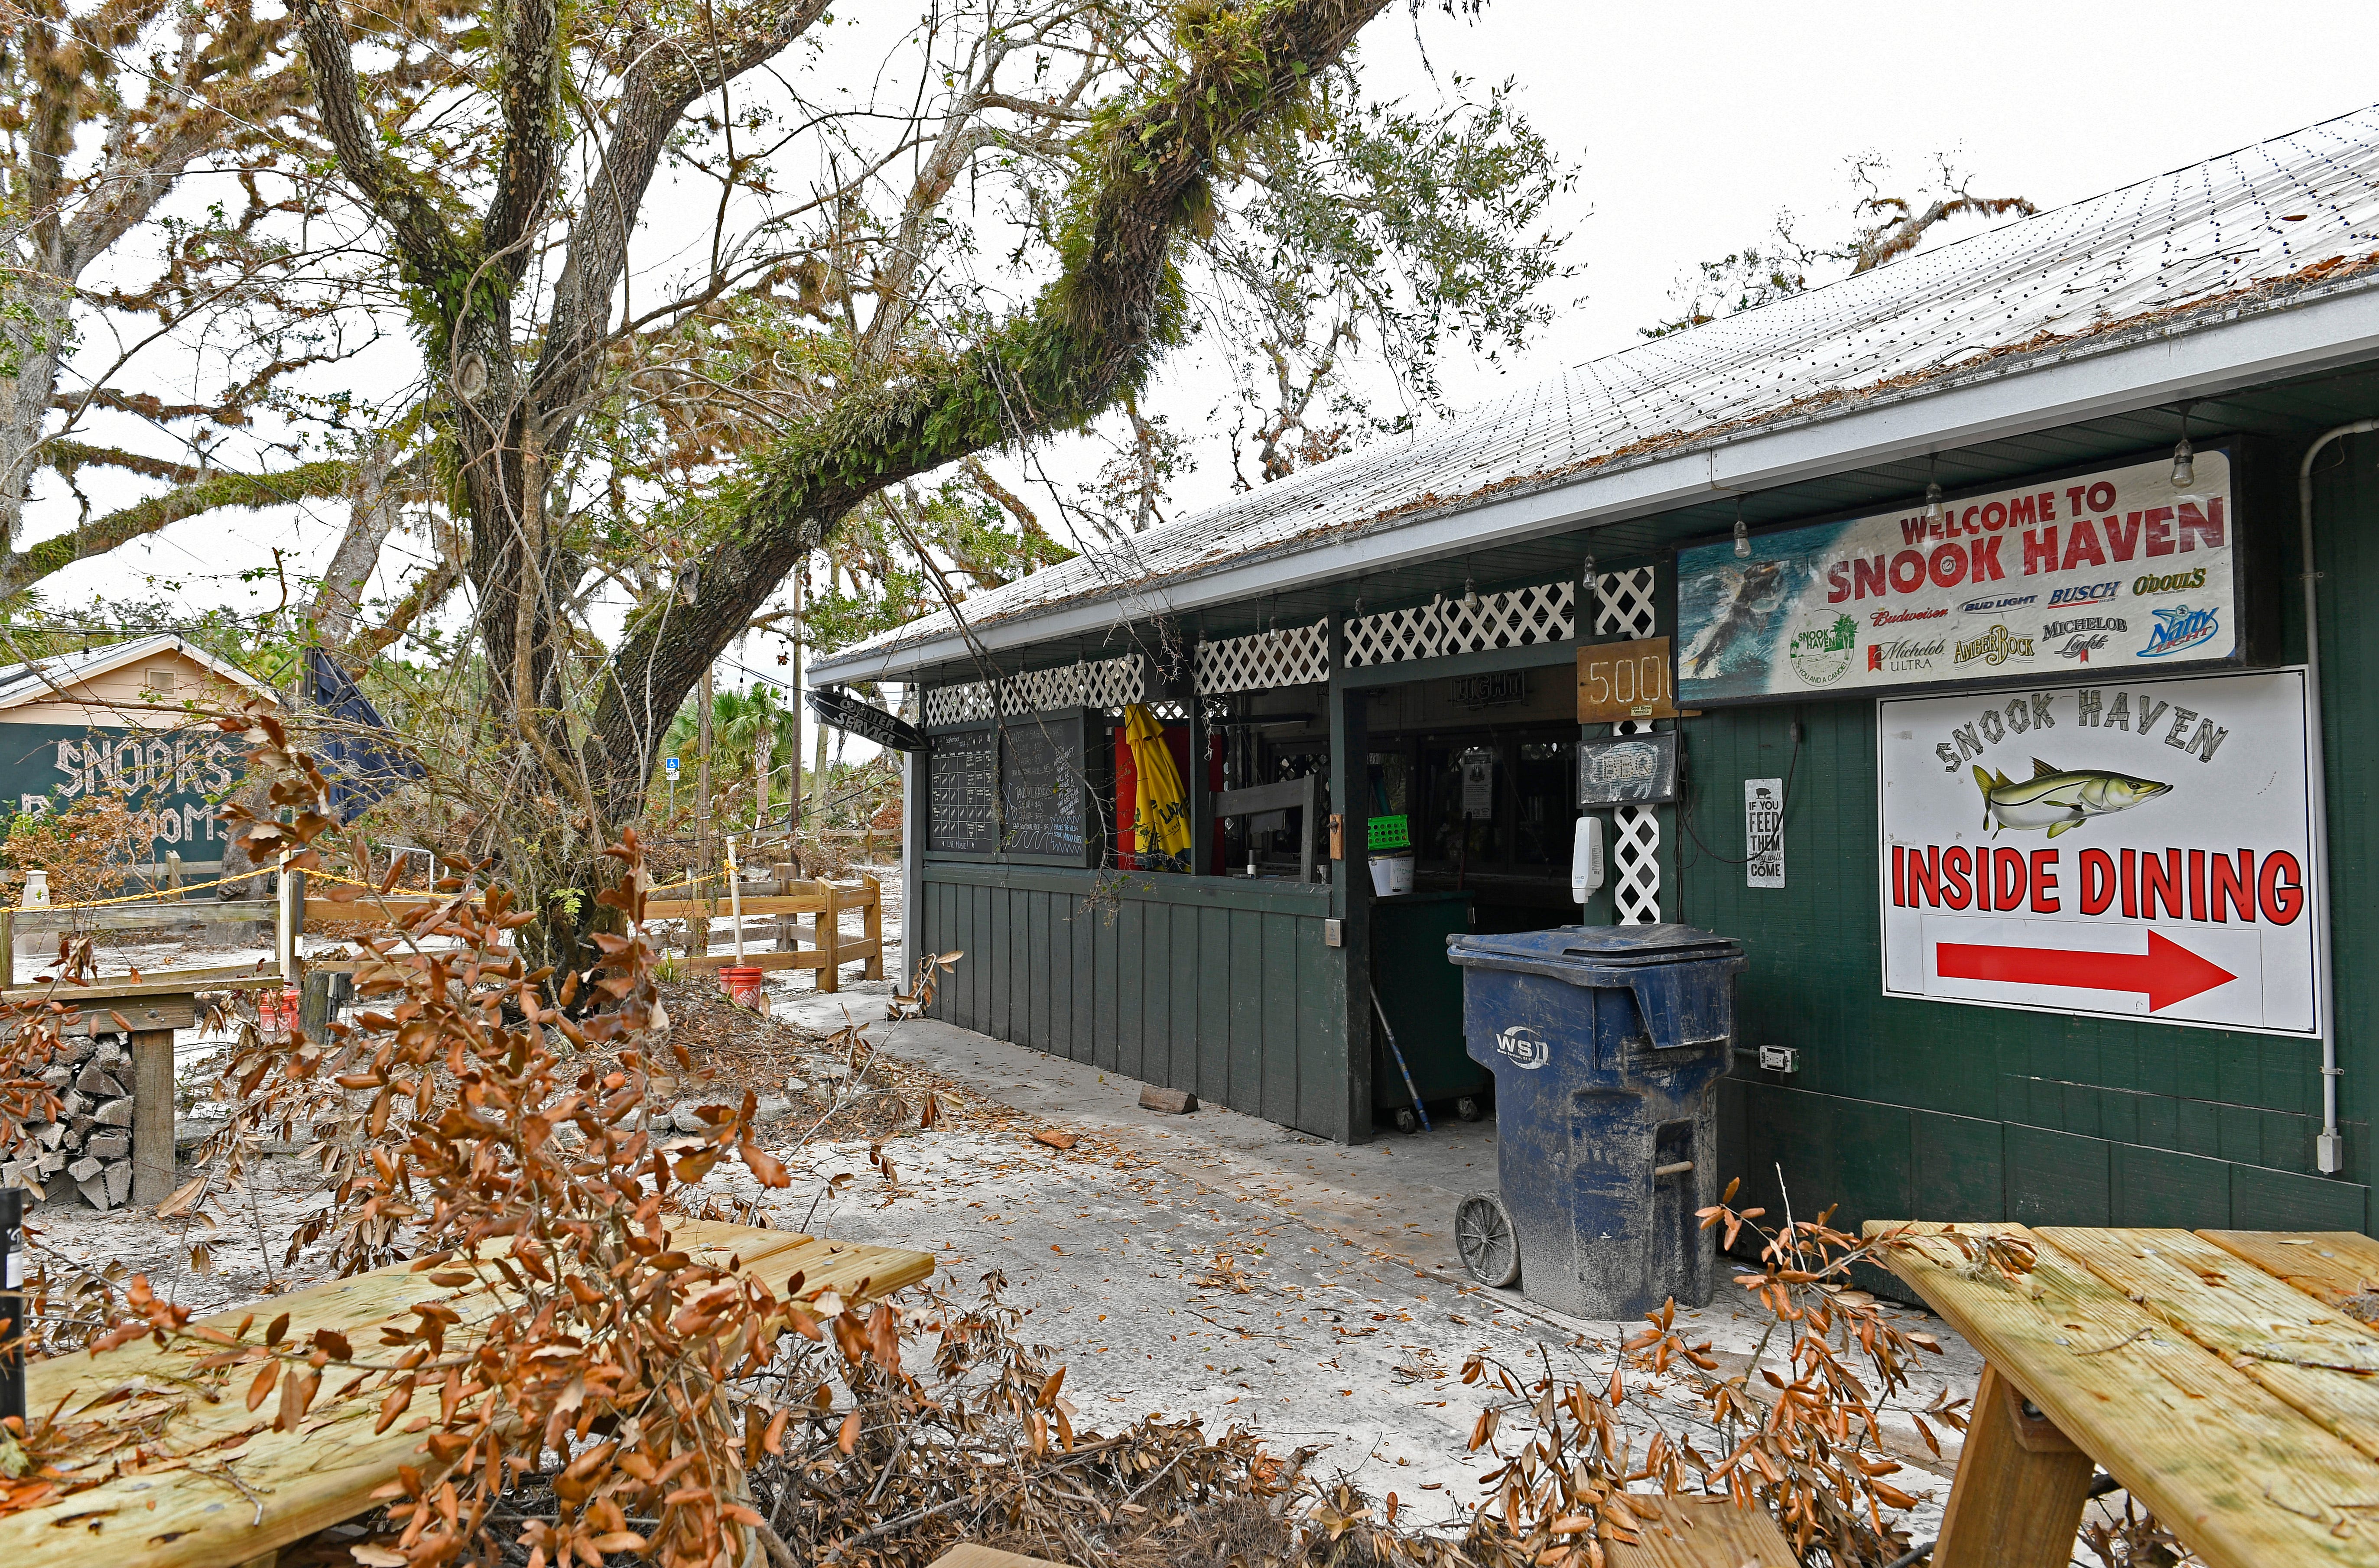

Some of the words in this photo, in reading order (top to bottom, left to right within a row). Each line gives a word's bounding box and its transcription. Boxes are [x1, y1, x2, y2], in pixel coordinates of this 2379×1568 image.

[1901, 498, 2055, 546] WELCOME
[2066, 481, 2116, 516] TO
[1828, 524, 2005, 603] SNOOK
[2023, 496, 2225, 576] HAVEN
[2048, 581, 2122, 605] BUSCH
[2132, 568, 2206, 596] O'DOUL'S
[1964, 600, 1996, 611] BUD
[1997, 595, 2038, 608] LIGHT
[1870, 607, 1949, 627] Budweiser
[2148, 607, 2219, 648] Natty
[1798, 629, 1830, 642] SNOOK
[2042, 617, 2128, 642] MICHELOB
[2156, 626, 2213, 653] LIGHT
[1807, 636, 1836, 650] HAVEN
[1874, 639, 1946, 662] Michelob
[2054, 634, 2109, 659] Light
[1798, 667, 1810, 680] YOU
[1827, 662, 1847, 681] CANOE!
[1891, 658, 1932, 672] ULTRA
[1590, 656, 1672, 704] 500
[840, 699, 896, 730] COUNTER
[834, 712, 896, 746] SERVICE
[1935, 692, 2056, 773] SNOOK
[2079, 690, 2229, 763] HAVEN
[54, 738, 233, 797] SNOOKS
[1065, 769, 1070, 779] BE
[1603, 752, 1652, 780] BBQ
[1749, 801, 1756, 810] IF
[1759, 801, 1779, 810] YOU
[1749, 812, 1780, 832] FEED
[1750, 835, 1780, 851] THEM
[1768, 852, 1782, 861] will
[1751, 864, 1781, 877] COME
[1892, 844, 2062, 915] INSIDE
[2079, 847, 2304, 927] DINING
